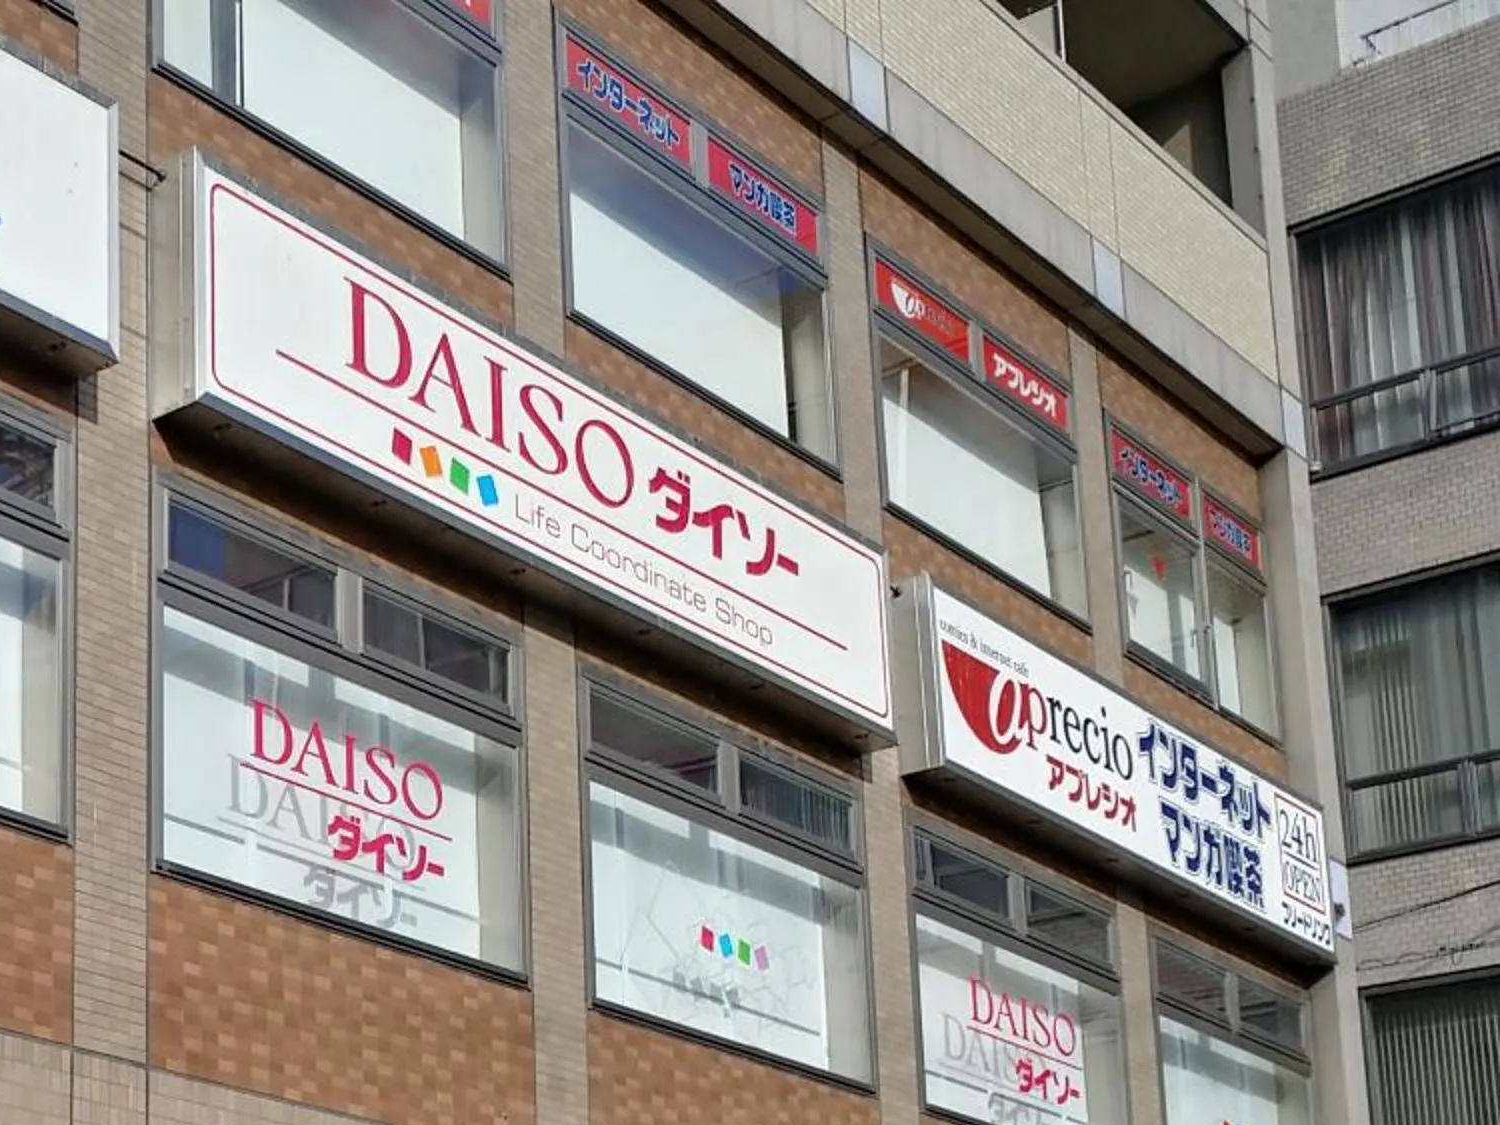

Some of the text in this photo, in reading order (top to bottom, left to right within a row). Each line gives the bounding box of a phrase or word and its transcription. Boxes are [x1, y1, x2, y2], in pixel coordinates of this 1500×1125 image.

[577, 58, 681, 150] インターネット
[344, 277, 799, 577] DAISO ダイソー
[514, 494, 773, 647] Life Coordinate Shop
[249, 697, 443, 820] DAISO
[970, 660, 1133, 780] aprecio
[1045, 753, 1138, 833] アプレシオ
[1137, 721, 1272, 841] インターネット
[328, 815, 444, 882] ダイソー
[1159, 798, 1266, 911] マンガ喫茶
[1279, 808, 1317, 863] 24h
[1282, 861, 1325, 904] OPEN
[969, 976, 1077, 1057] DAISO
[1015, 1057, 1081, 1105] ダイソー
